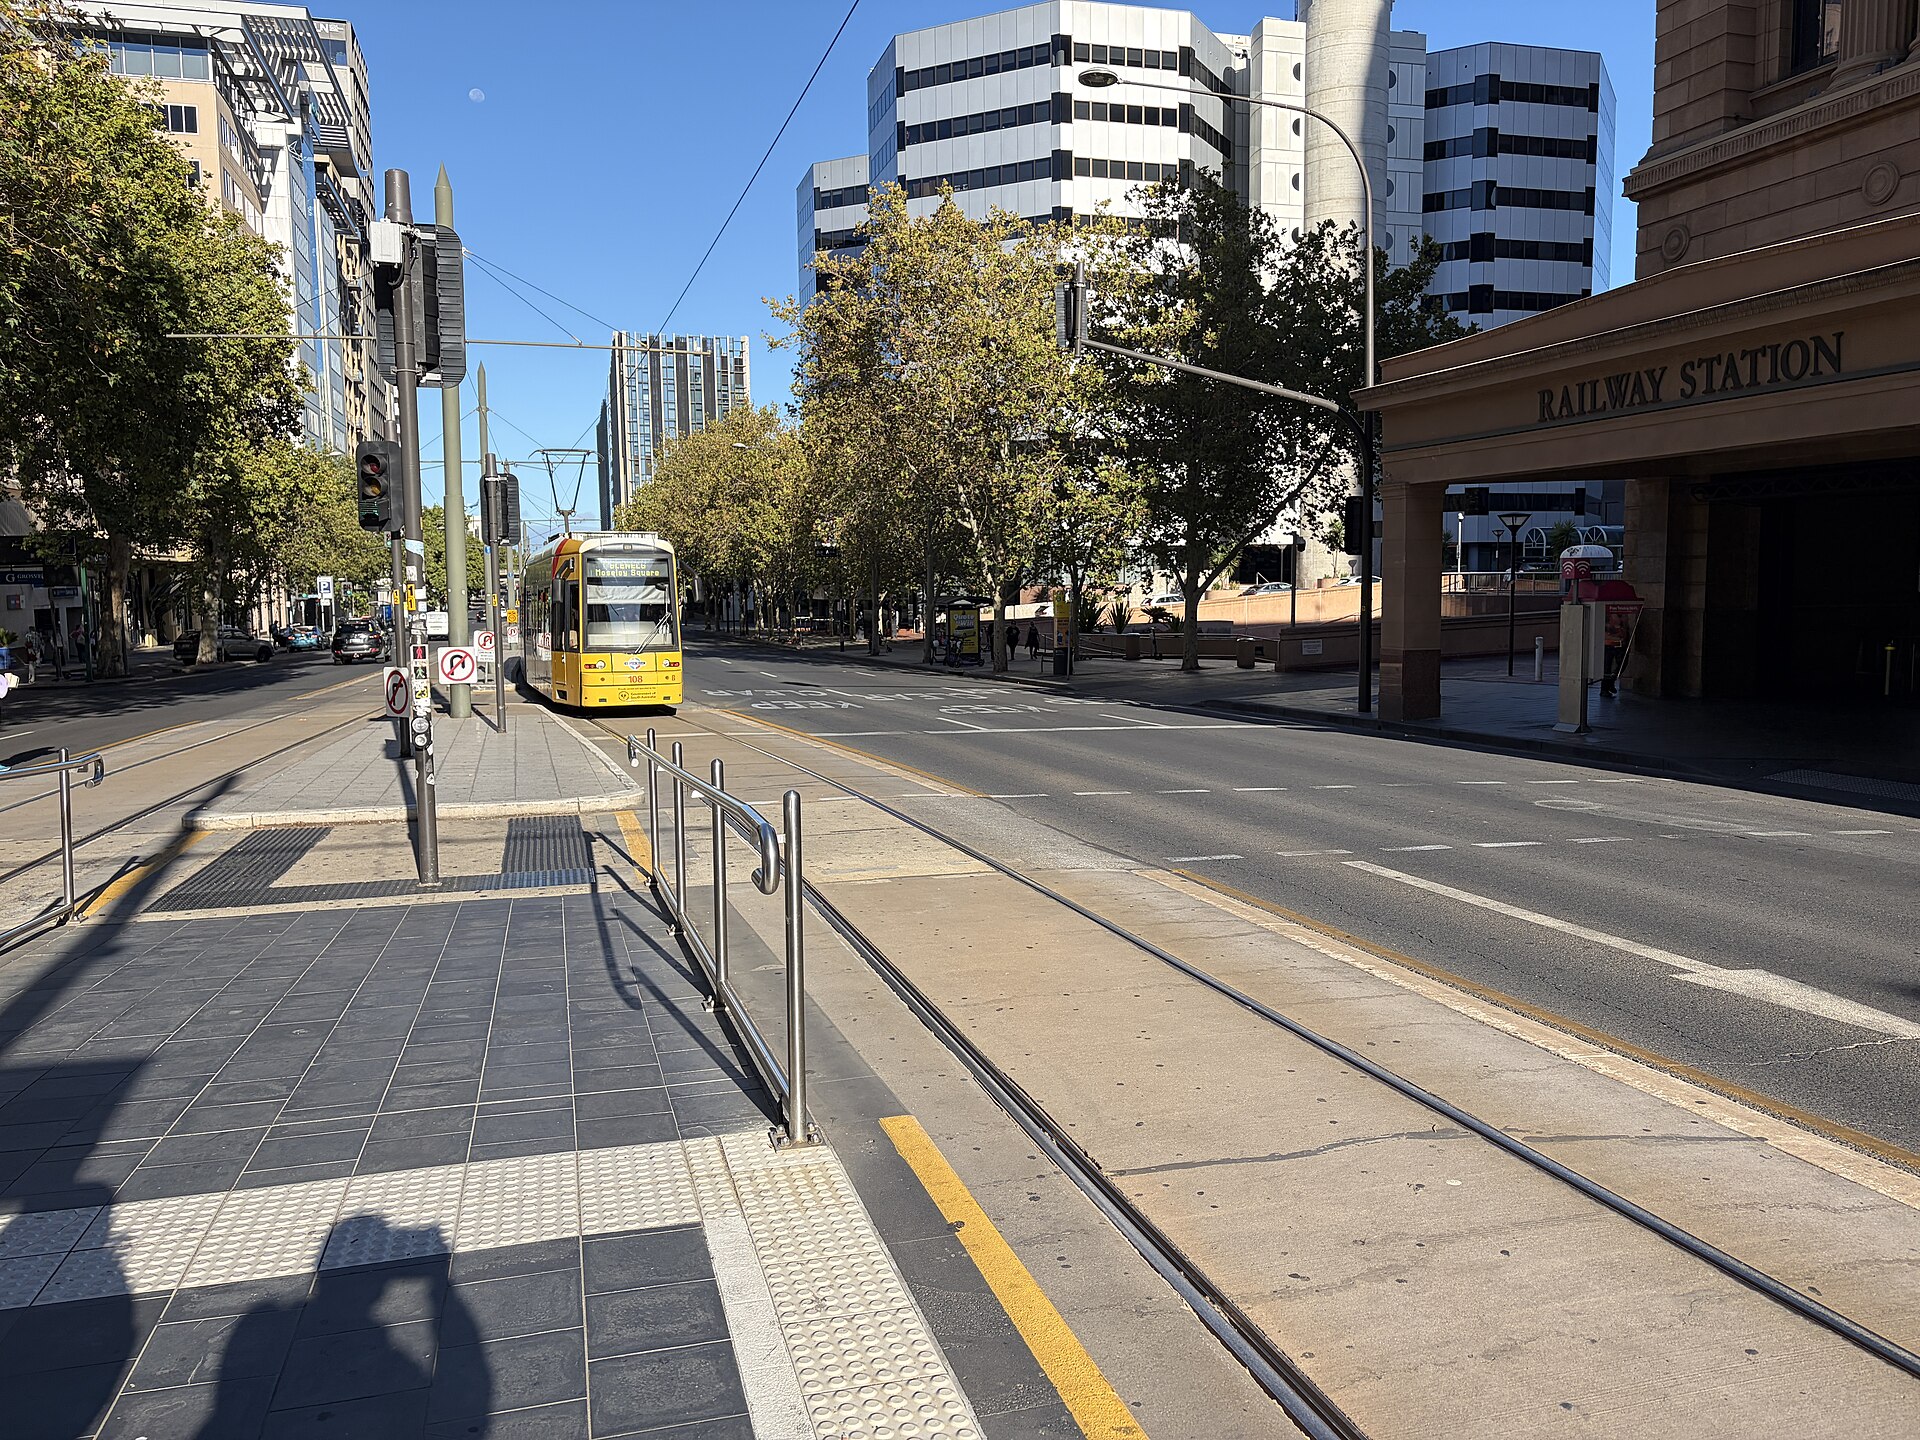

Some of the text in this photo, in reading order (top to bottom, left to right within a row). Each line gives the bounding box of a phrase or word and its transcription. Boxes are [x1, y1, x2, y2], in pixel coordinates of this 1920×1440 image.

[1537, 331, 1845, 423] RAILWAY STATION
[630, 569, 660, 577] Square
[628, 675, 643, 684] 108
[700, 689, 828, 697] CLEAR
[751, 700, 864, 710] KEEP
[938, 704, 1060, 715] KEEP
